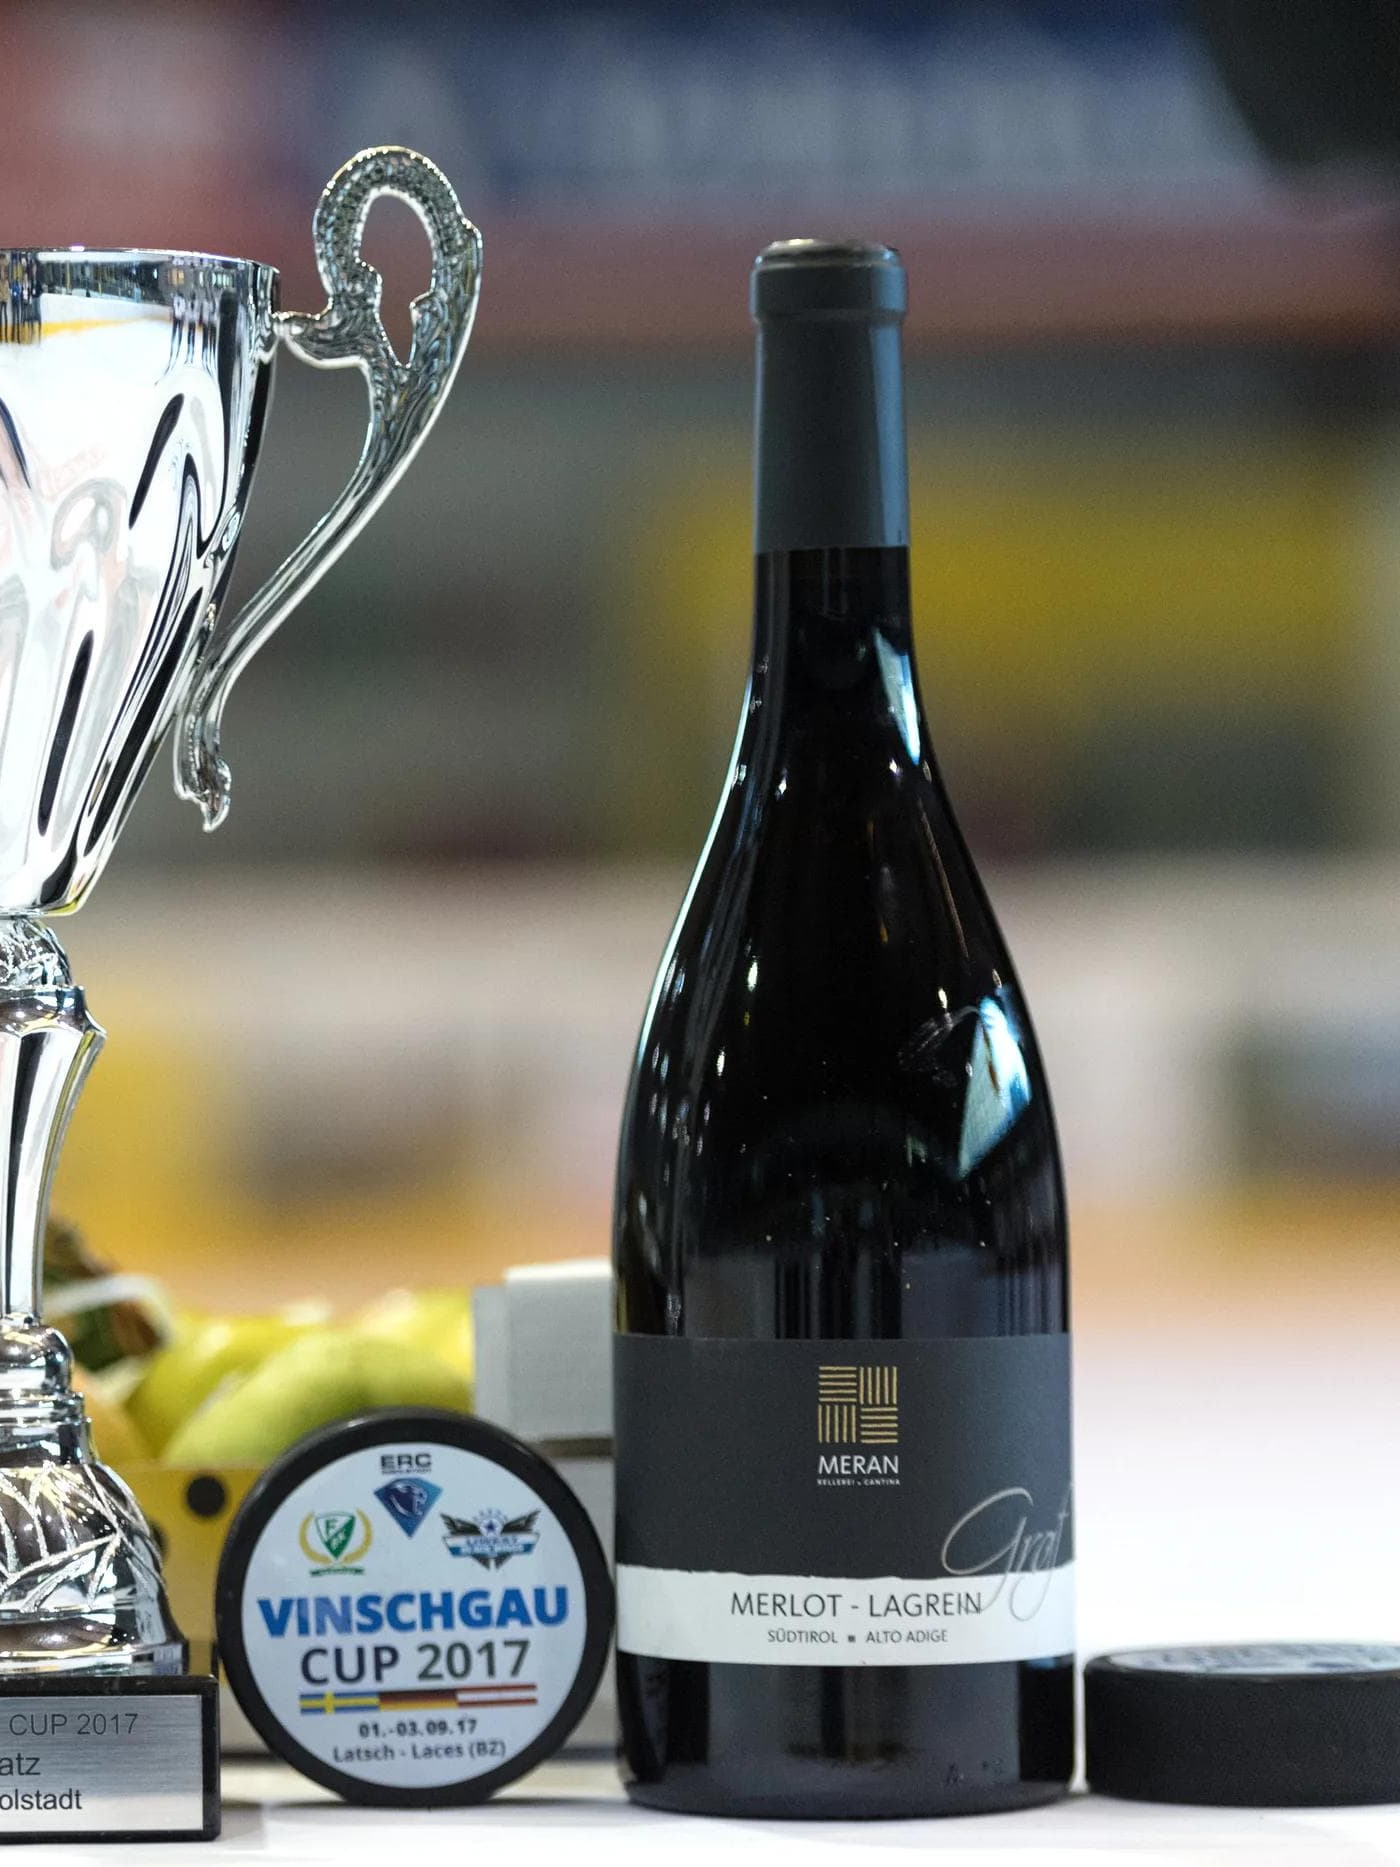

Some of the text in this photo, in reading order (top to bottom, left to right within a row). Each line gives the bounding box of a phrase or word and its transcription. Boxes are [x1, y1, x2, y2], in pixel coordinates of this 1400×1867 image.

[380, 1453, 432, 1468] ERC
[817, 1454, 899, 1475] MERAN
[816, 1478, 901, 1487] KELLEREI CANTINA
[257, 1586, 569, 1638] VINSCHGAU
[731, 1591, 843, 1618] MERLOT
[869, 1590, 982, 1617] LAGREIN
[767, 1627, 949, 1644] SÜDTIROL ALTO ADIGE
[300, 1639, 531, 1685] CUP 2017
[8, 1713, 68, 1737] CUP
[76, 1712, 139, 1736] 2017
[333, 1743, 395, 1763] Latsch
[412, 1741, 464, 1760] Laces
[469, 1739, 507, 1759] (BZ)
